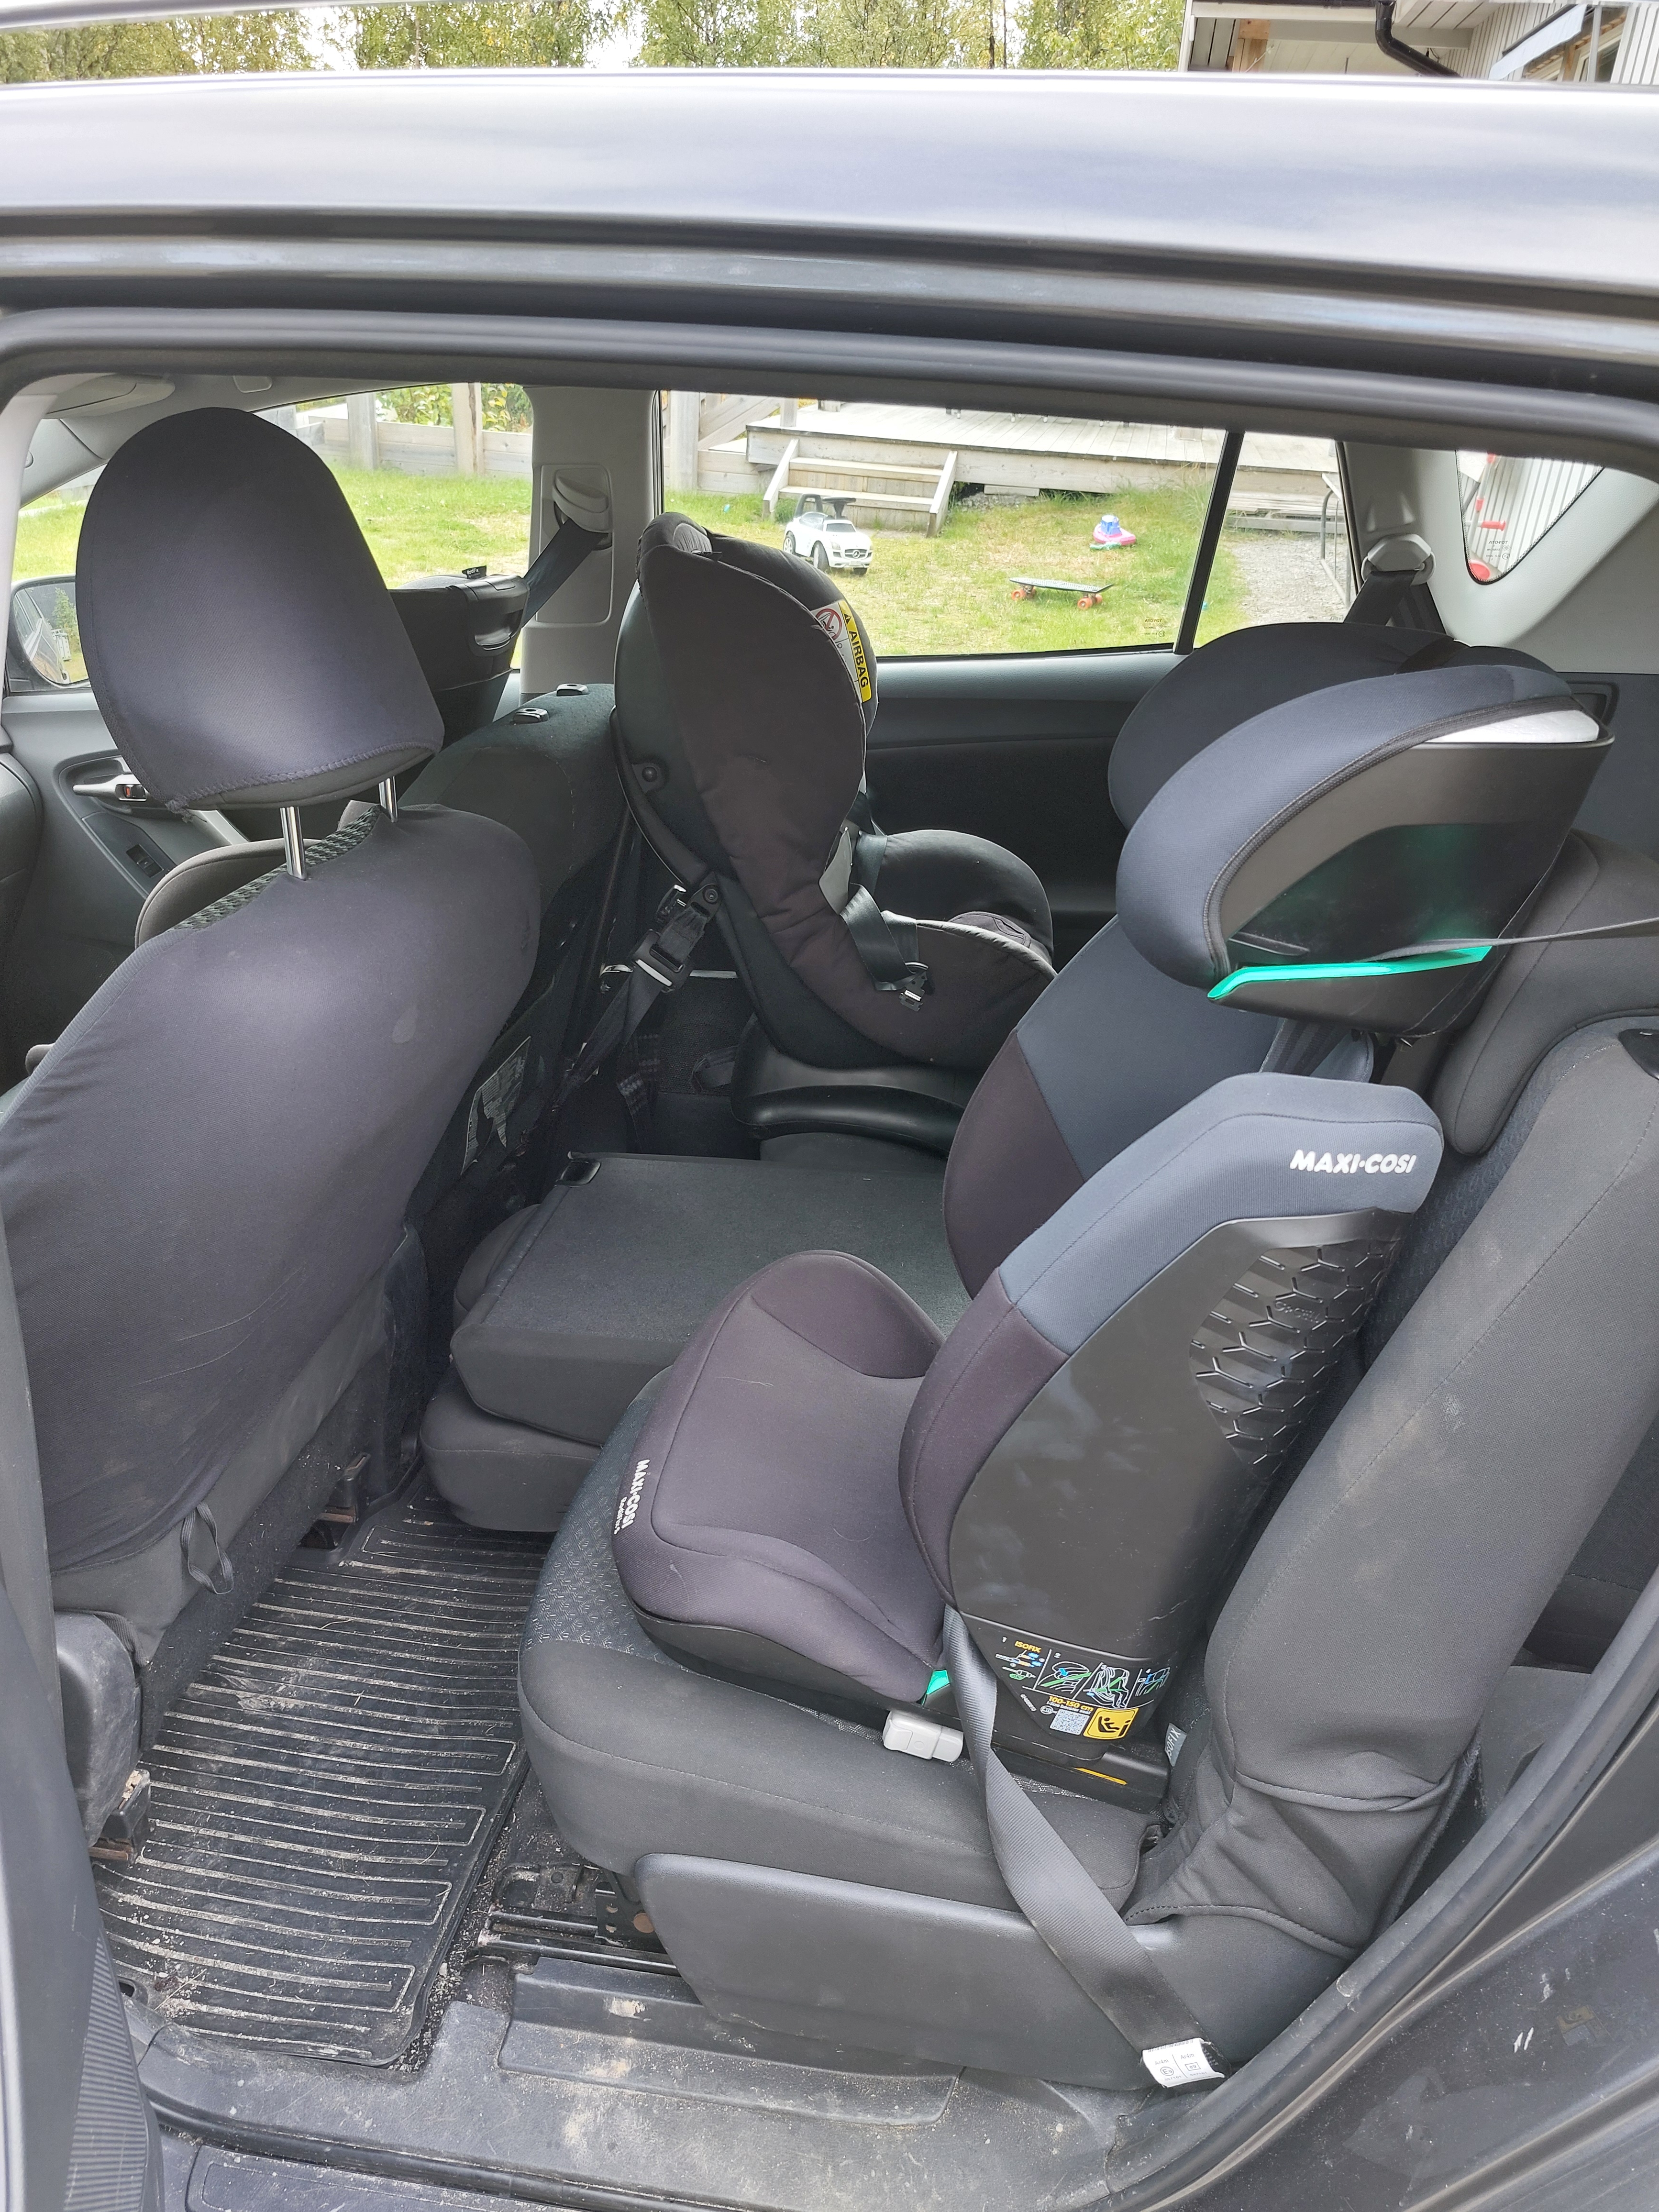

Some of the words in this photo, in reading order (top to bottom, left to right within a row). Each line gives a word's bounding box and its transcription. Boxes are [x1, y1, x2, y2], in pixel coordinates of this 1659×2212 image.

[849, 630, 869, 688] AIRBAG
[1015, 1640, 1042, 1653] ISOFIX
[1049, 1695, 1080, 1708] 100-150
[1166, 1727, 1181, 1760] ISOFIX
